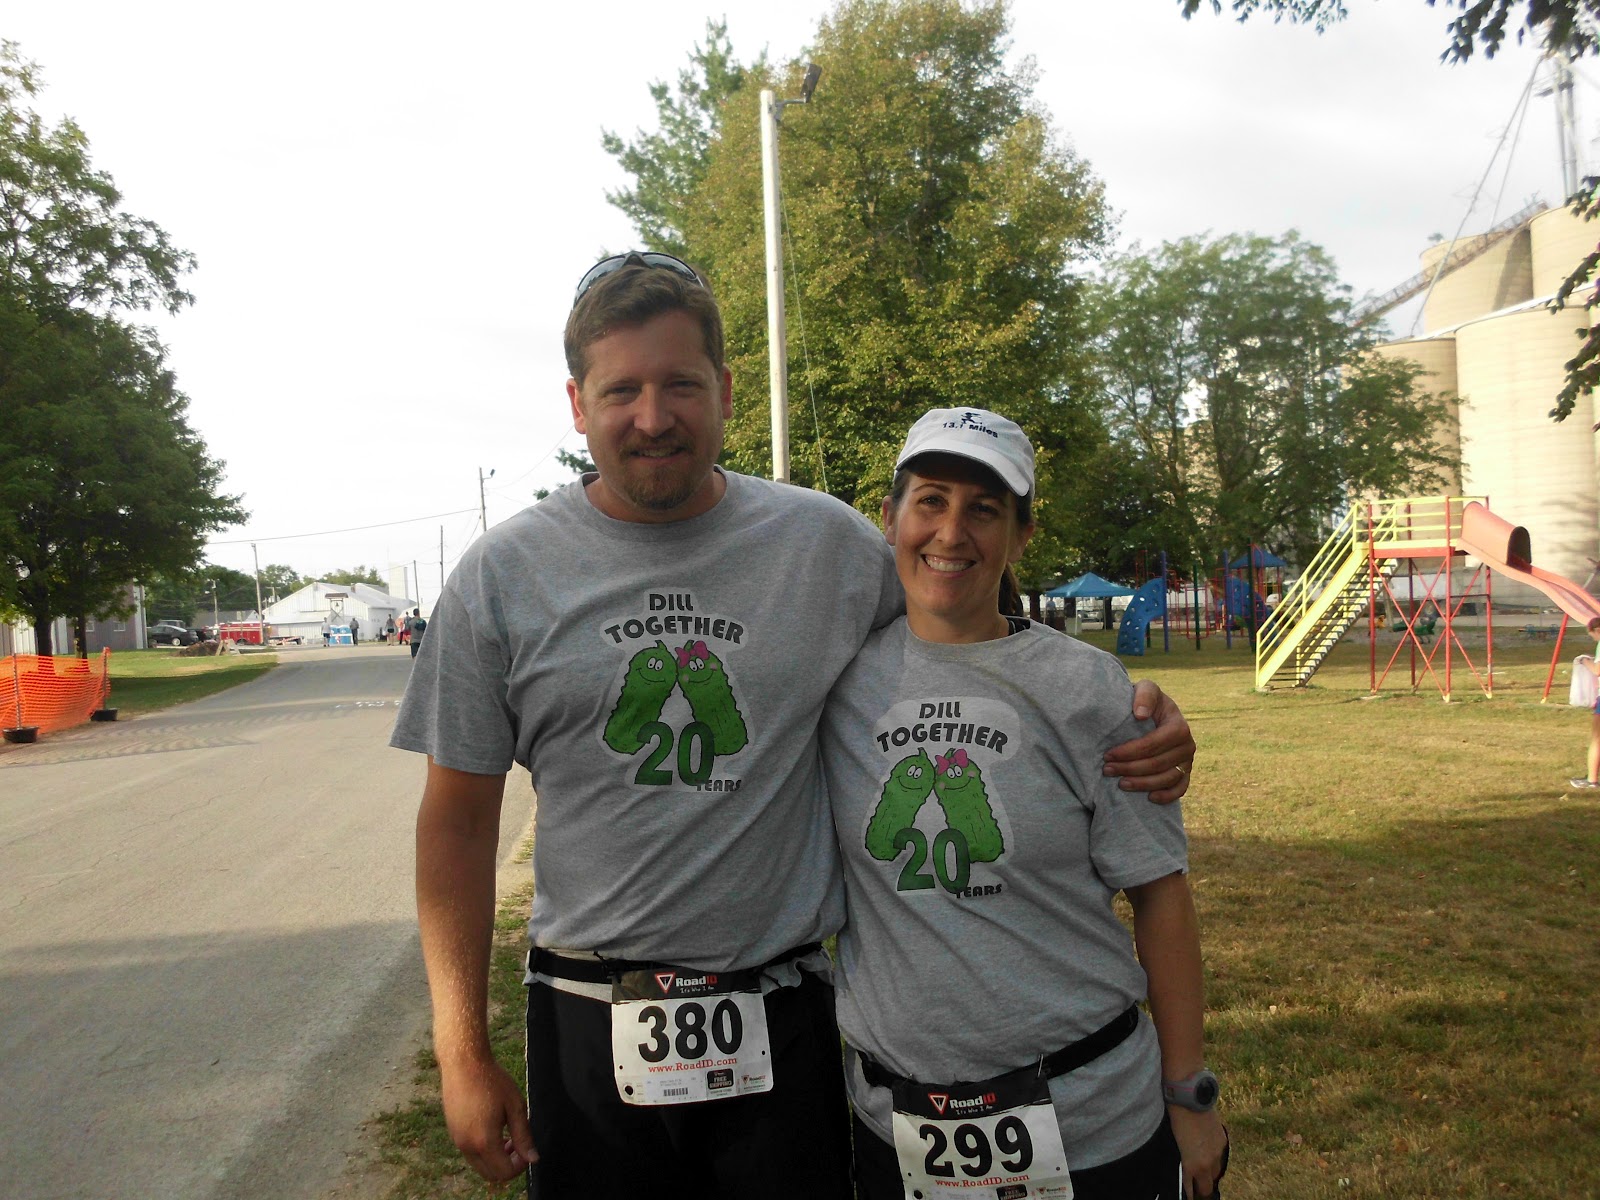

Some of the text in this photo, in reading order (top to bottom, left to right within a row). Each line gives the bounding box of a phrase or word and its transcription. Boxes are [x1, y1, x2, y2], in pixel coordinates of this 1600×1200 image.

[968, 424, 998, 438] Miles
[649, 593, 694, 611] DILL
[604, 615, 744, 644] TOGETHER
[919, 701, 961, 719] DILL
[876, 722, 1008, 754] TOGETHER
[634, 721, 715, 786] 20
[893, 828, 970, 894] 20
[637, 998, 743, 1063] 380
[648, 1057, 737, 1073] www.RoadID.com
[919, 1115, 1034, 1178] 299
[935, 1173, 1030, 1188] www.RoadID.com
